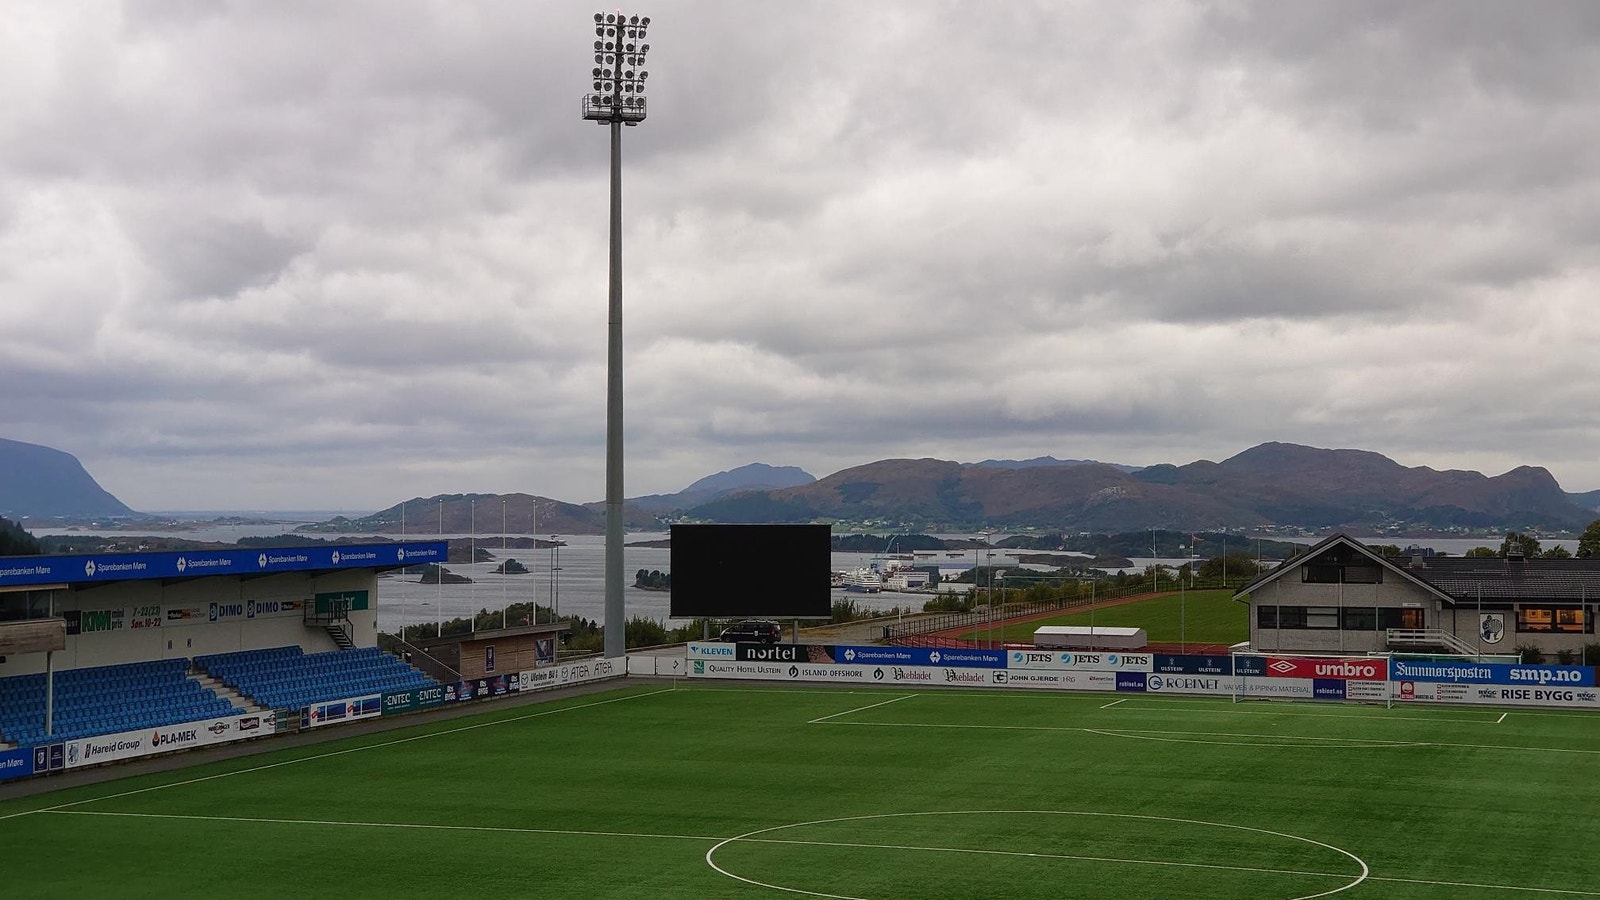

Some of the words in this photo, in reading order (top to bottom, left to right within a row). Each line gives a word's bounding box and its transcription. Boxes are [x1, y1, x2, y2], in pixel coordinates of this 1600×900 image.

[268, 555, 296, 564] Sparebanken
[340, 553, 365, 561] Sparebanken
[405, 550, 427, 558] Sparebanken
[98, 562, 132, 572] Sparebanken
[133, 562, 146, 570] Møre
[187, 559, 218, 568] Sparebanken
[0, 566, 33, 576] parebanken
[35, 566, 51, 574] Møre
[219, 604, 243, 617] DIMO
[256, 602, 278, 614] DIMO
[82, 610, 111, 632] KIWI
[112, 619, 123, 631] pris
[747, 646, 796, 660] nortel
[943, 653, 983, 662] Sparebanken
[1025, 653, 1052, 666] JETS
[1072, 654, 1100, 666] JETS
[1120, 655, 1148, 667] JETS
[1315, 663, 1375, 677] umbro
[1395, 662, 1492, 682] Sunnmørsposten
[1510, 668, 1582, 684] smp.no
[1166, 678, 1220, 689] ROBINET
[387, 693, 411, 706] ENTEC
[419, 688, 442, 701] ENTEC
[1502, 689, 1530, 700] RISE
[1535, 690, 1573, 701] BYGG
[160, 730, 197, 746] PLA-MEK
[92, 742, 116, 755] Hareid
[117, 740, 140, 751] Group
[7, 758, 24, 768] Møre
